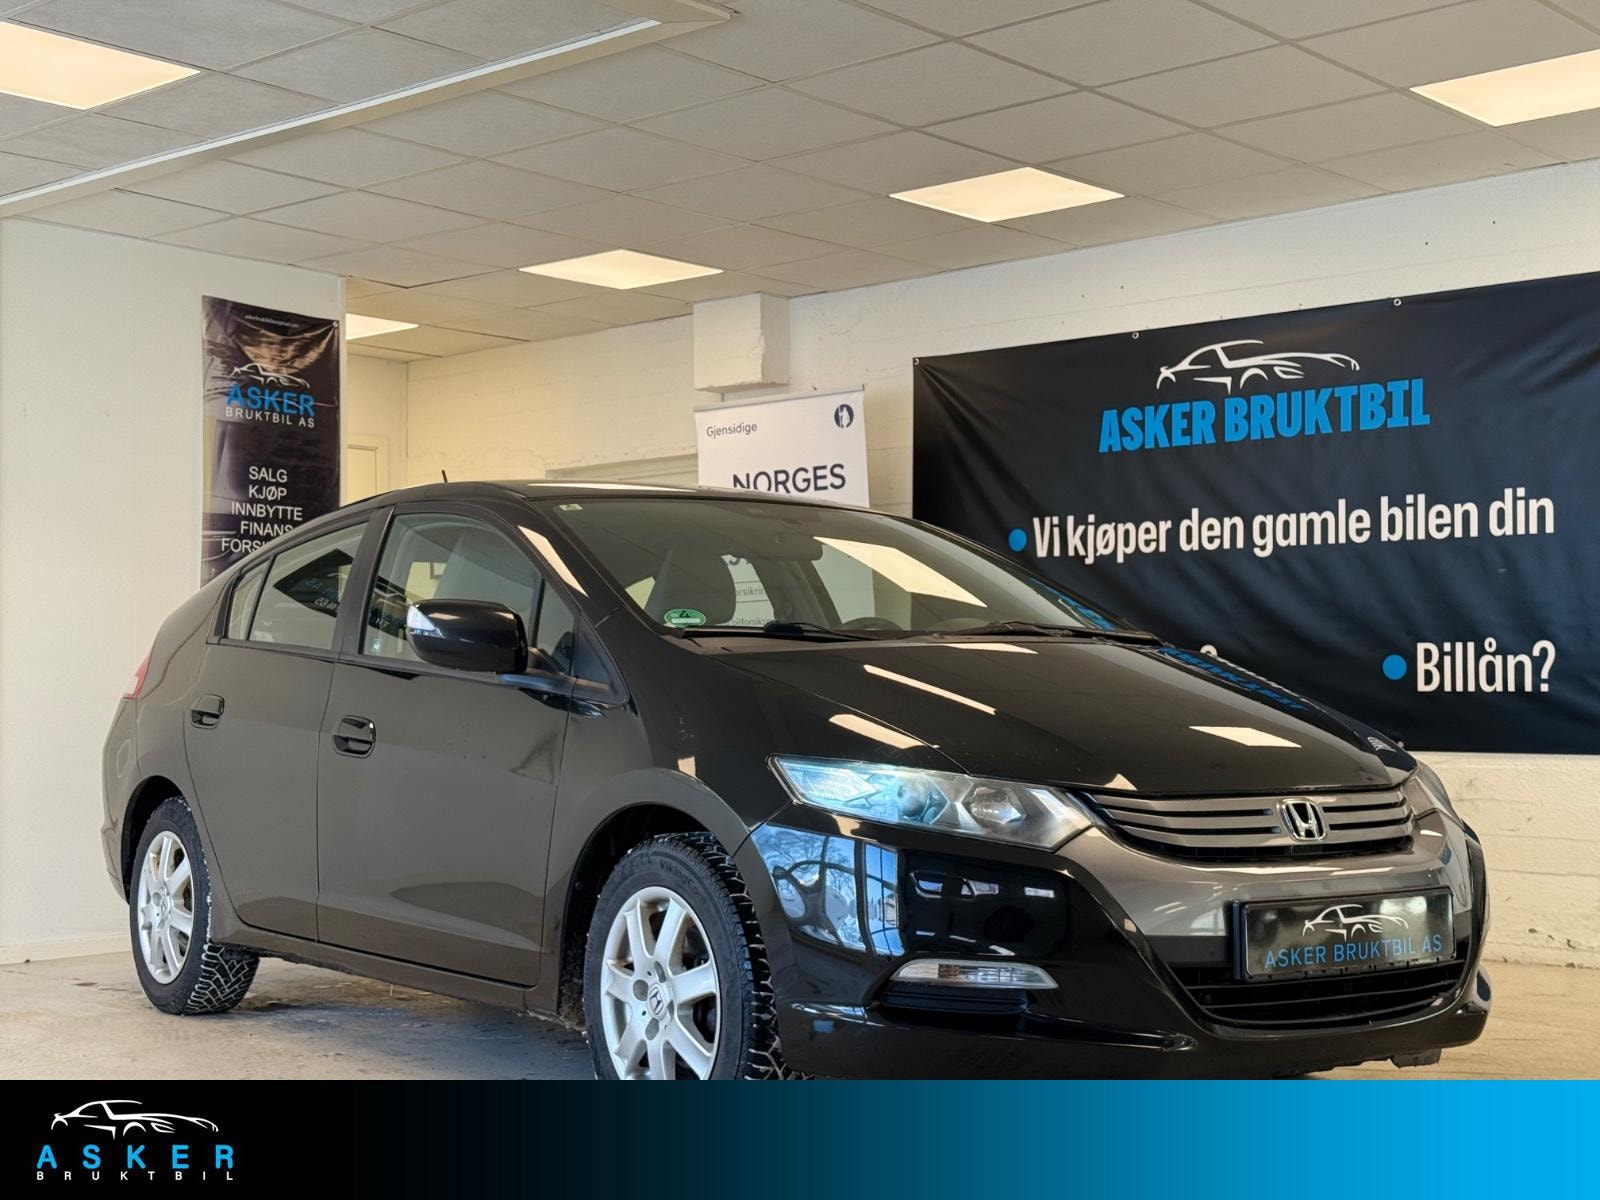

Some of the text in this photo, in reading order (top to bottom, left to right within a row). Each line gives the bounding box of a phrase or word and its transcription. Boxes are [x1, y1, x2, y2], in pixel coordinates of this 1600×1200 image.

[227, 383, 315, 417] ASKER
[226, 406, 315, 428] BRUKTBIL AS
[1099, 378, 1430, 453] ASKER BRUKTBIL
[706, 422, 758, 439] Gjensidige
[249, 466, 288, 483] SALG
[733, 463, 846, 494] NORGES
[249, 484, 287, 501] KJØP
[231, 501, 303, 521] INNBYTTE
[1033, 486, 1555, 565] Vi kjøper den gamle bilen din
[221, 537, 270, 553] FORS
[1416, 637, 1556, 693] Billån?
[1265, 934, 1442, 969] ASKER BRUKTBIL AS
